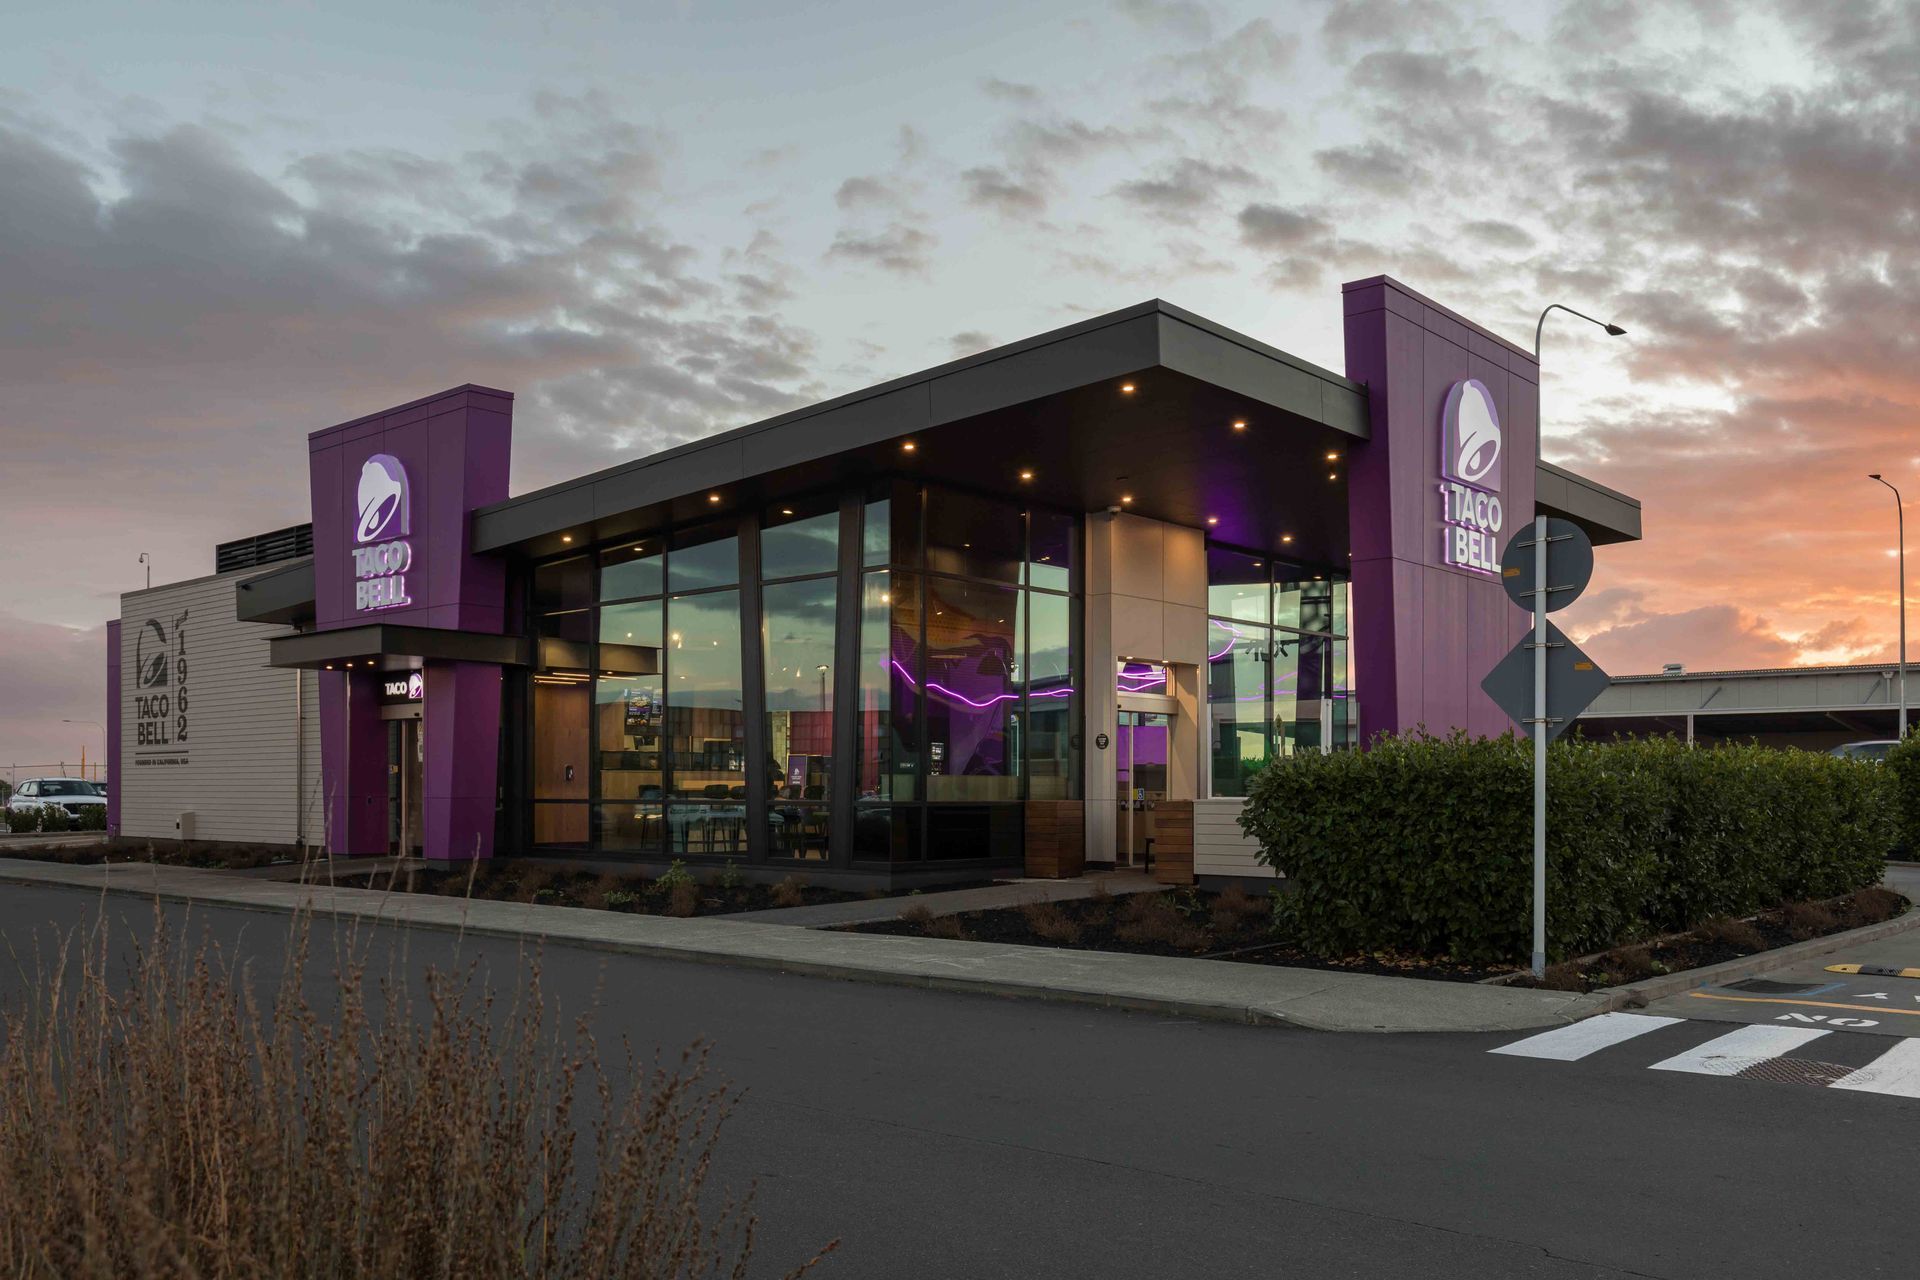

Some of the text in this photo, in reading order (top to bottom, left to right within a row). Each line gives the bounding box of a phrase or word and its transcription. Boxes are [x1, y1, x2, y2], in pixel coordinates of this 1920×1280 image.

[1449, 482, 1502, 533] TACO
[352, 541, 407, 578] TACO
[1453, 526, 1502, 573] BELL
[356, 575, 409, 611] BELL
[177, 629, 189, 742] 1962
[384, 681, 408, 696] TACO
[135, 694, 170, 720] TACO
[137, 721, 169, 745] BELL
